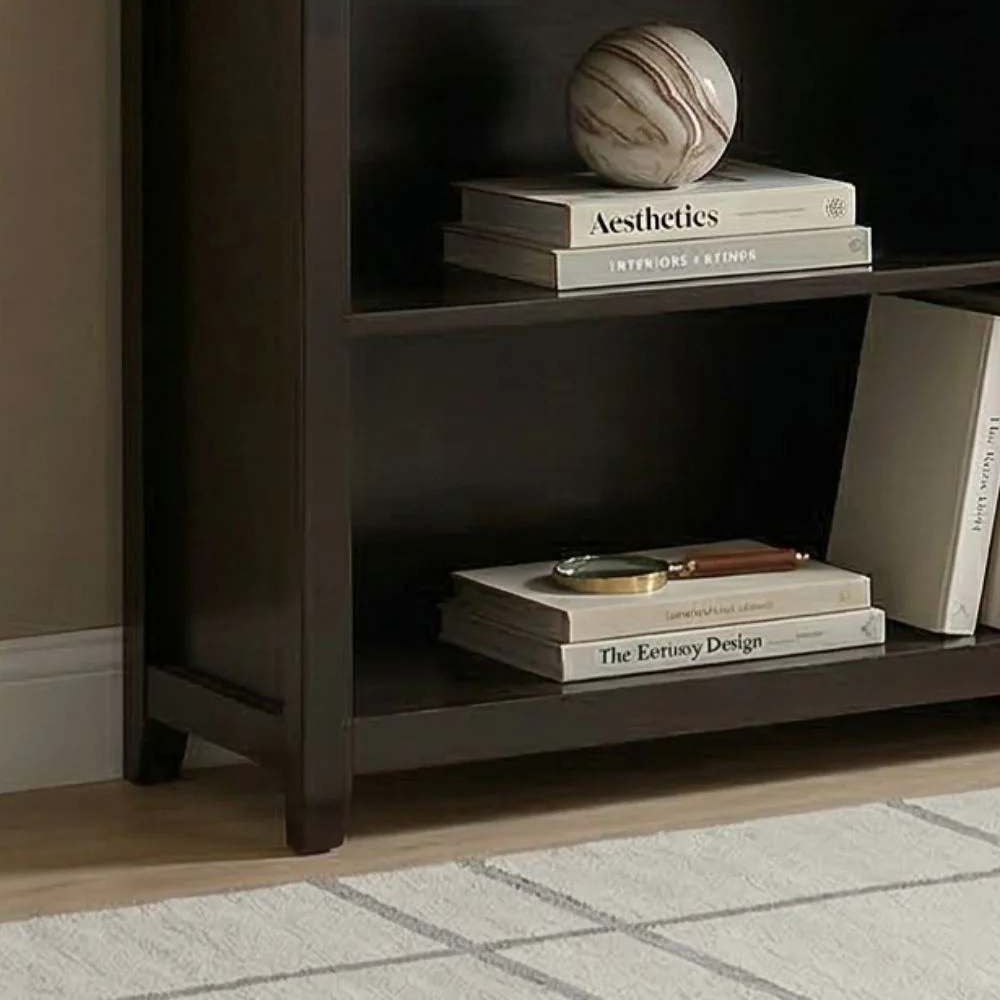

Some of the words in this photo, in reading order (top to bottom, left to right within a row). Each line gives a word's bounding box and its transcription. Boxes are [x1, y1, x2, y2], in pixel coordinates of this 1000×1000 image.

[589, 204, 719, 236] Aesthetics
[600, 646, 630, 664] The
[707, 633, 763, 655] Design
